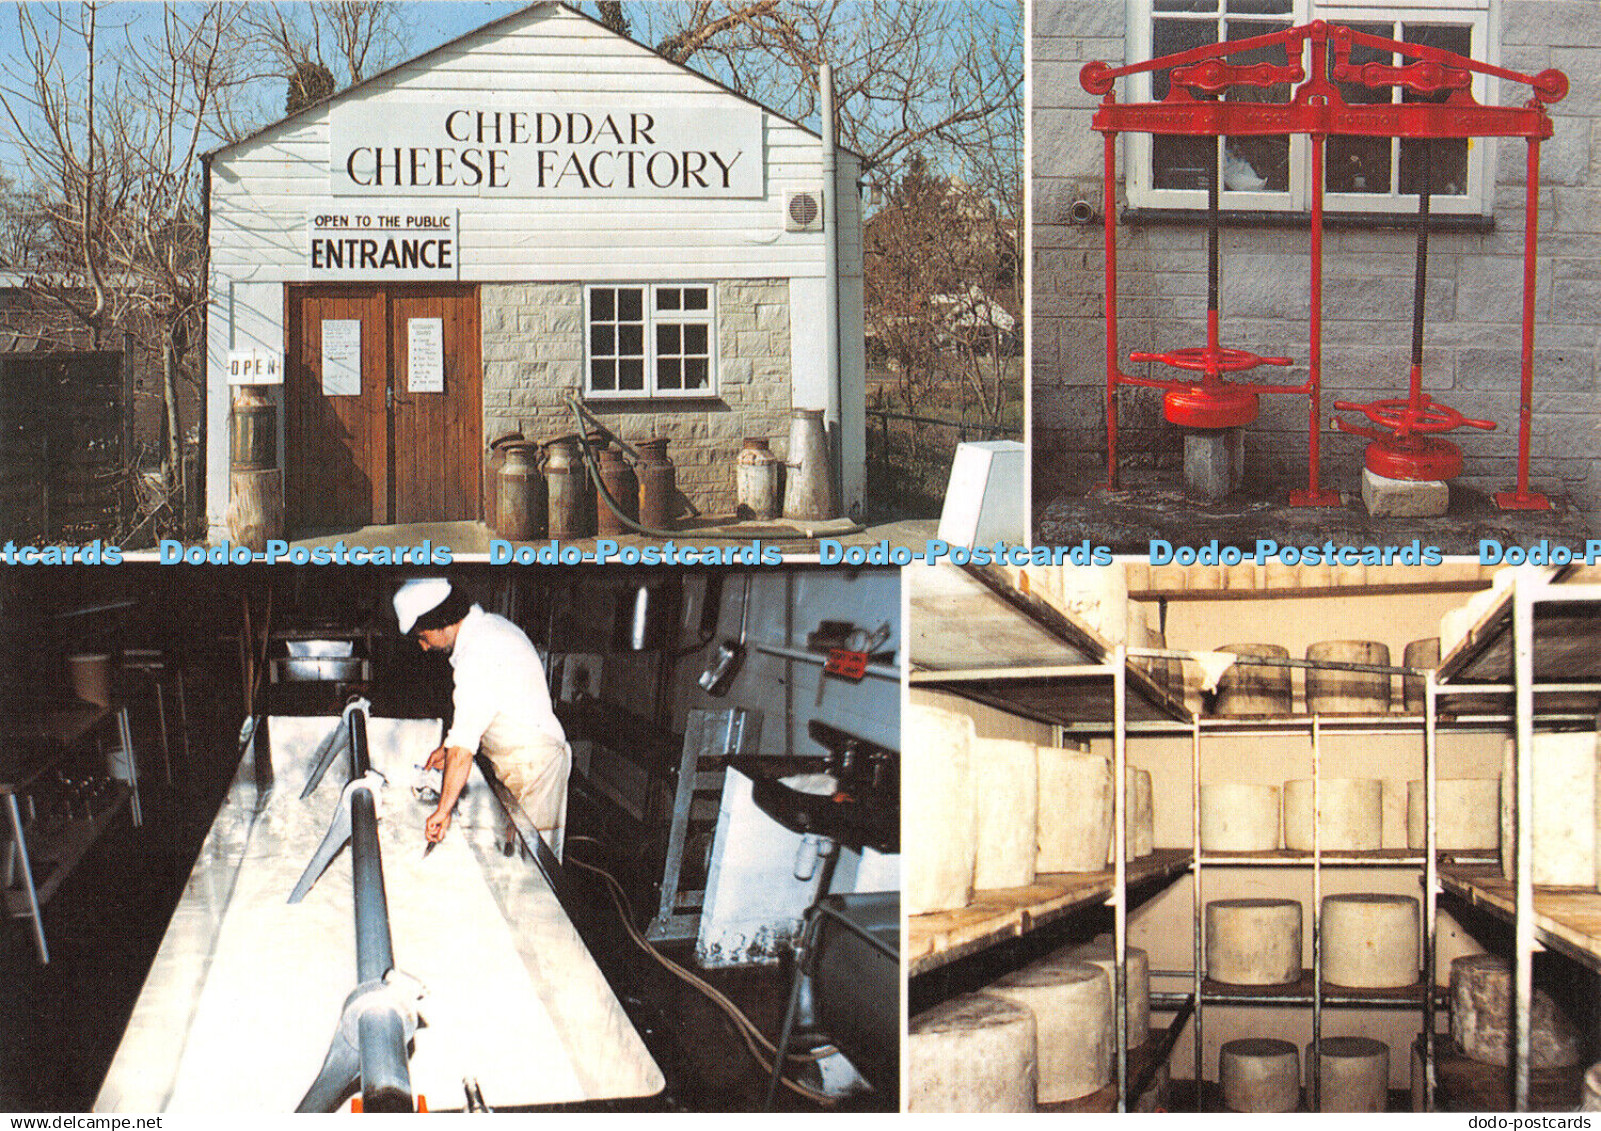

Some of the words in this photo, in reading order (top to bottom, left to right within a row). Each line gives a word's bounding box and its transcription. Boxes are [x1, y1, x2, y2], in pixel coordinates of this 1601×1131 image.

[445, 110, 656, 145] CHEDDAR
[346, 148, 511, 188] CHEESE
[537, 149, 744, 189] FACTORY
[314, 215, 349, 227] OPEN
[356, 215, 371, 227] TO
[377, 216, 400, 228] THE
[406, 216, 450, 228] PUBLIC
[311, 238, 452, 269] ENTRANCE
[231, 359, 276, 376] OPEN
